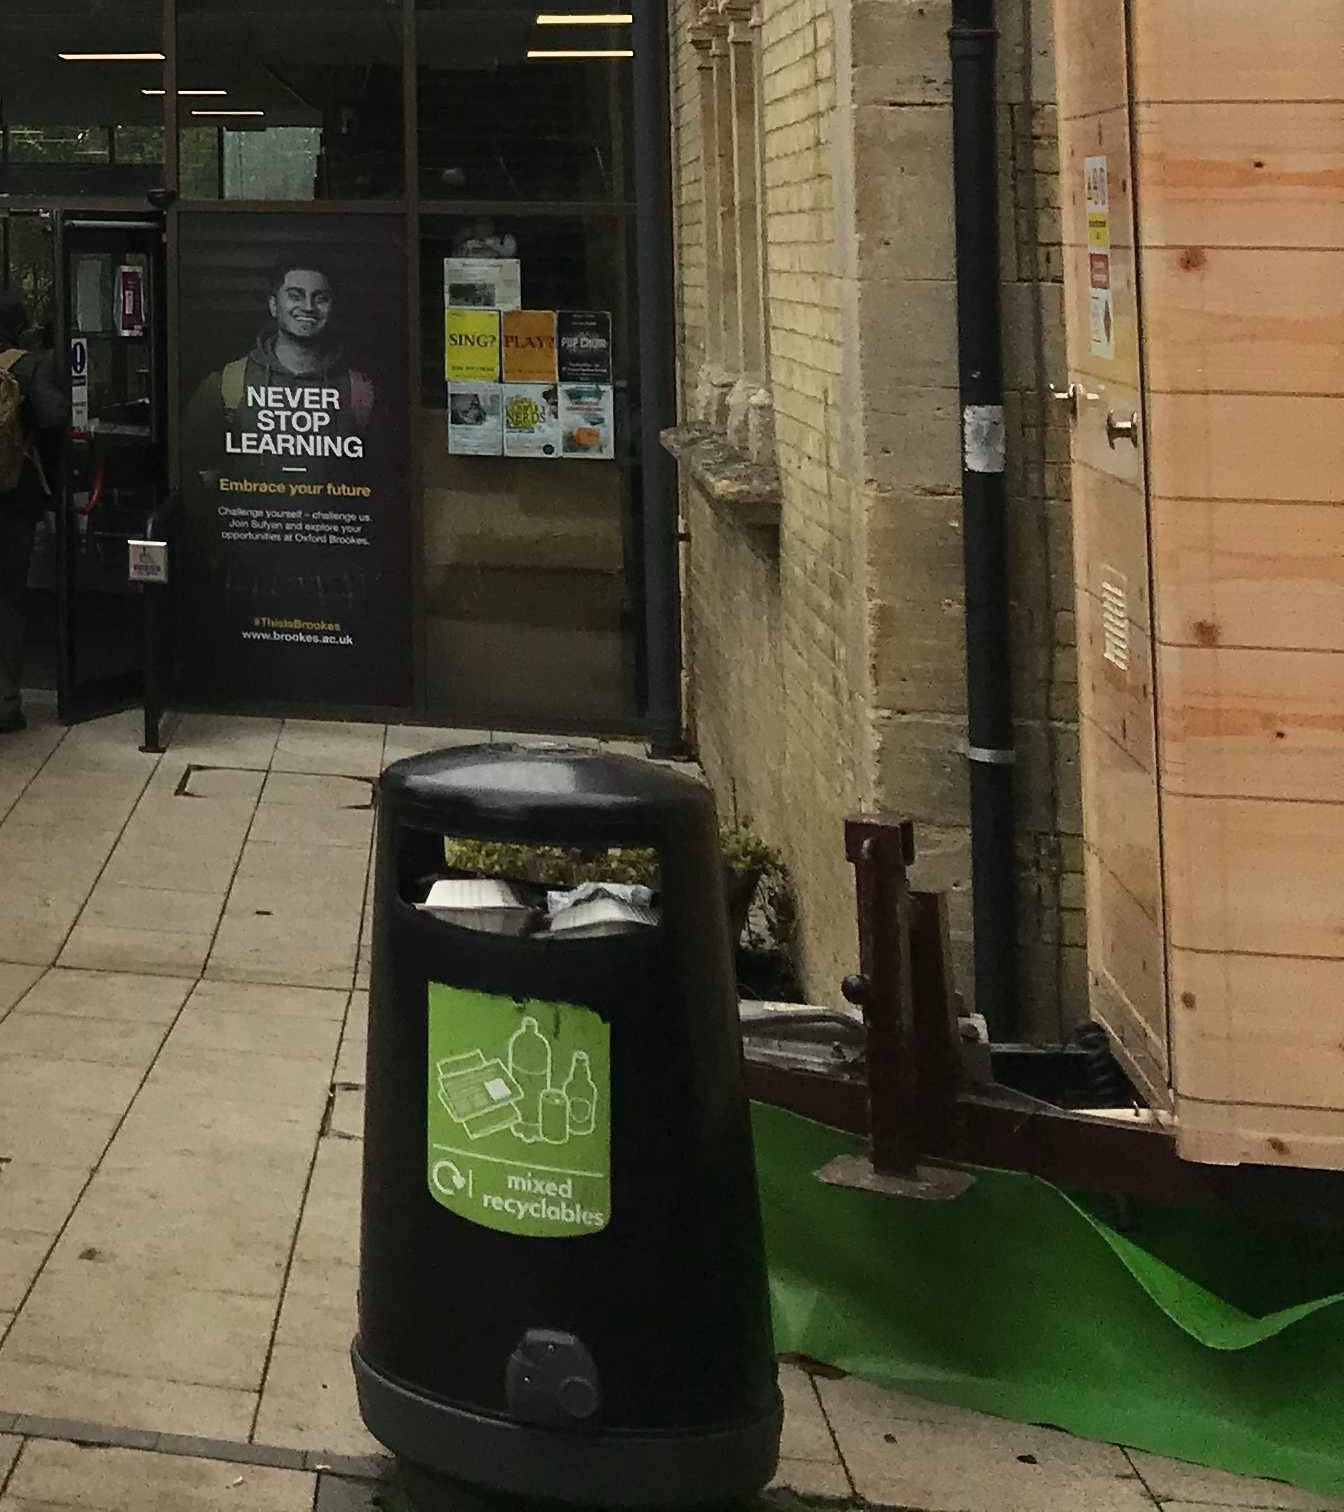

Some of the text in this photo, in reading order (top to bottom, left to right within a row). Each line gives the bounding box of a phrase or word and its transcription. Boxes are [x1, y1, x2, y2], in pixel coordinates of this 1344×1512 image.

[448, 333, 496, 348] SING?
[504, 335, 555, 349] PLAY?
[247, 386, 340, 410] NEVER
[256, 410, 330, 432] STOP
[226, 432, 363, 458] LEARNING
[219, 478, 372, 497] Embrace your future
[217, 506, 264, 519] Challenge
[265, 508, 302, 519] yourself
[312, 511, 357, 523] challenge
[229, 519, 249, 528] Join
[285, 521, 303, 530] and
[304, 522, 339, 533] explore
[340, 524, 362, 535] your
[221, 531, 371, 546] opportunities at Oxford Brookes.
[242, 631, 353, 646] www.brookes.ac.uk
[507, 1172, 572, 1198] mixed
[483, 1194, 604, 1226] recyclables
